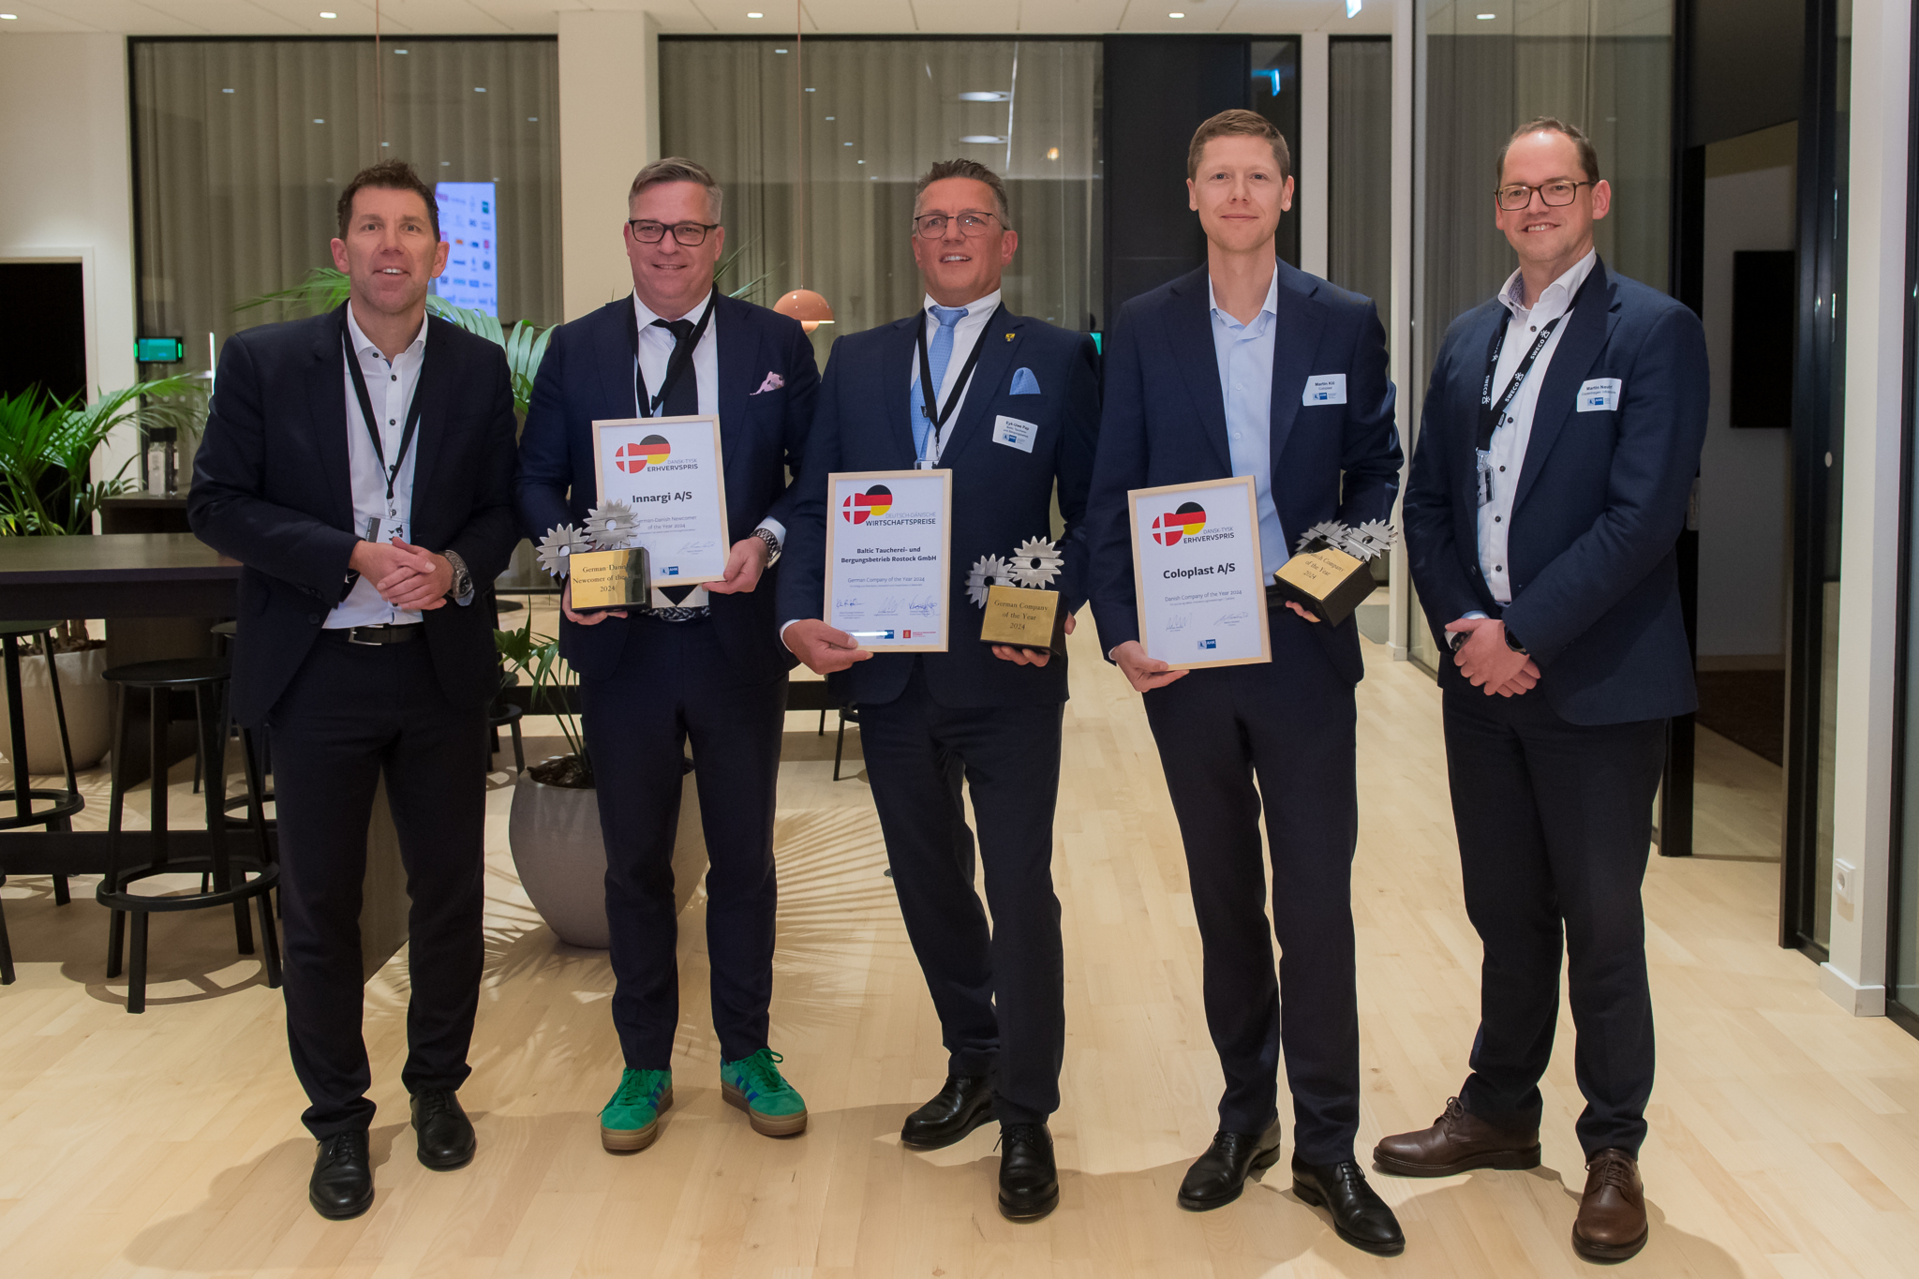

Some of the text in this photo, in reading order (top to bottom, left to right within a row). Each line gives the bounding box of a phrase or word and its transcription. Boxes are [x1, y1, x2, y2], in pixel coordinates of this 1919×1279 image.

[1530, 339, 1545, 360] SWECO
[1482, 375, 1490, 395] SWECO
[1504, 382, 1520, 402] SWECO
[647, 464, 698, 472] ERHVERVSPRIS
[632, 492, 692, 504] Innargi A/S
[866, 518, 936, 526] WIRTSCHAFTSPREISE
[1203, 526, 1233, 534] DANSK-TYSK
[1183, 532, 1234, 544] ERHVERVSPRIS
[1323, 558, 1344, 572] Company
[1163, 563, 1236, 579] Coloplast A/S
[1303, 570, 1317, 580] 2024
[1320, 567, 1330, 576] Year
[1182, 594, 1203, 602] Company
[1019, 602, 1048, 612] Company
